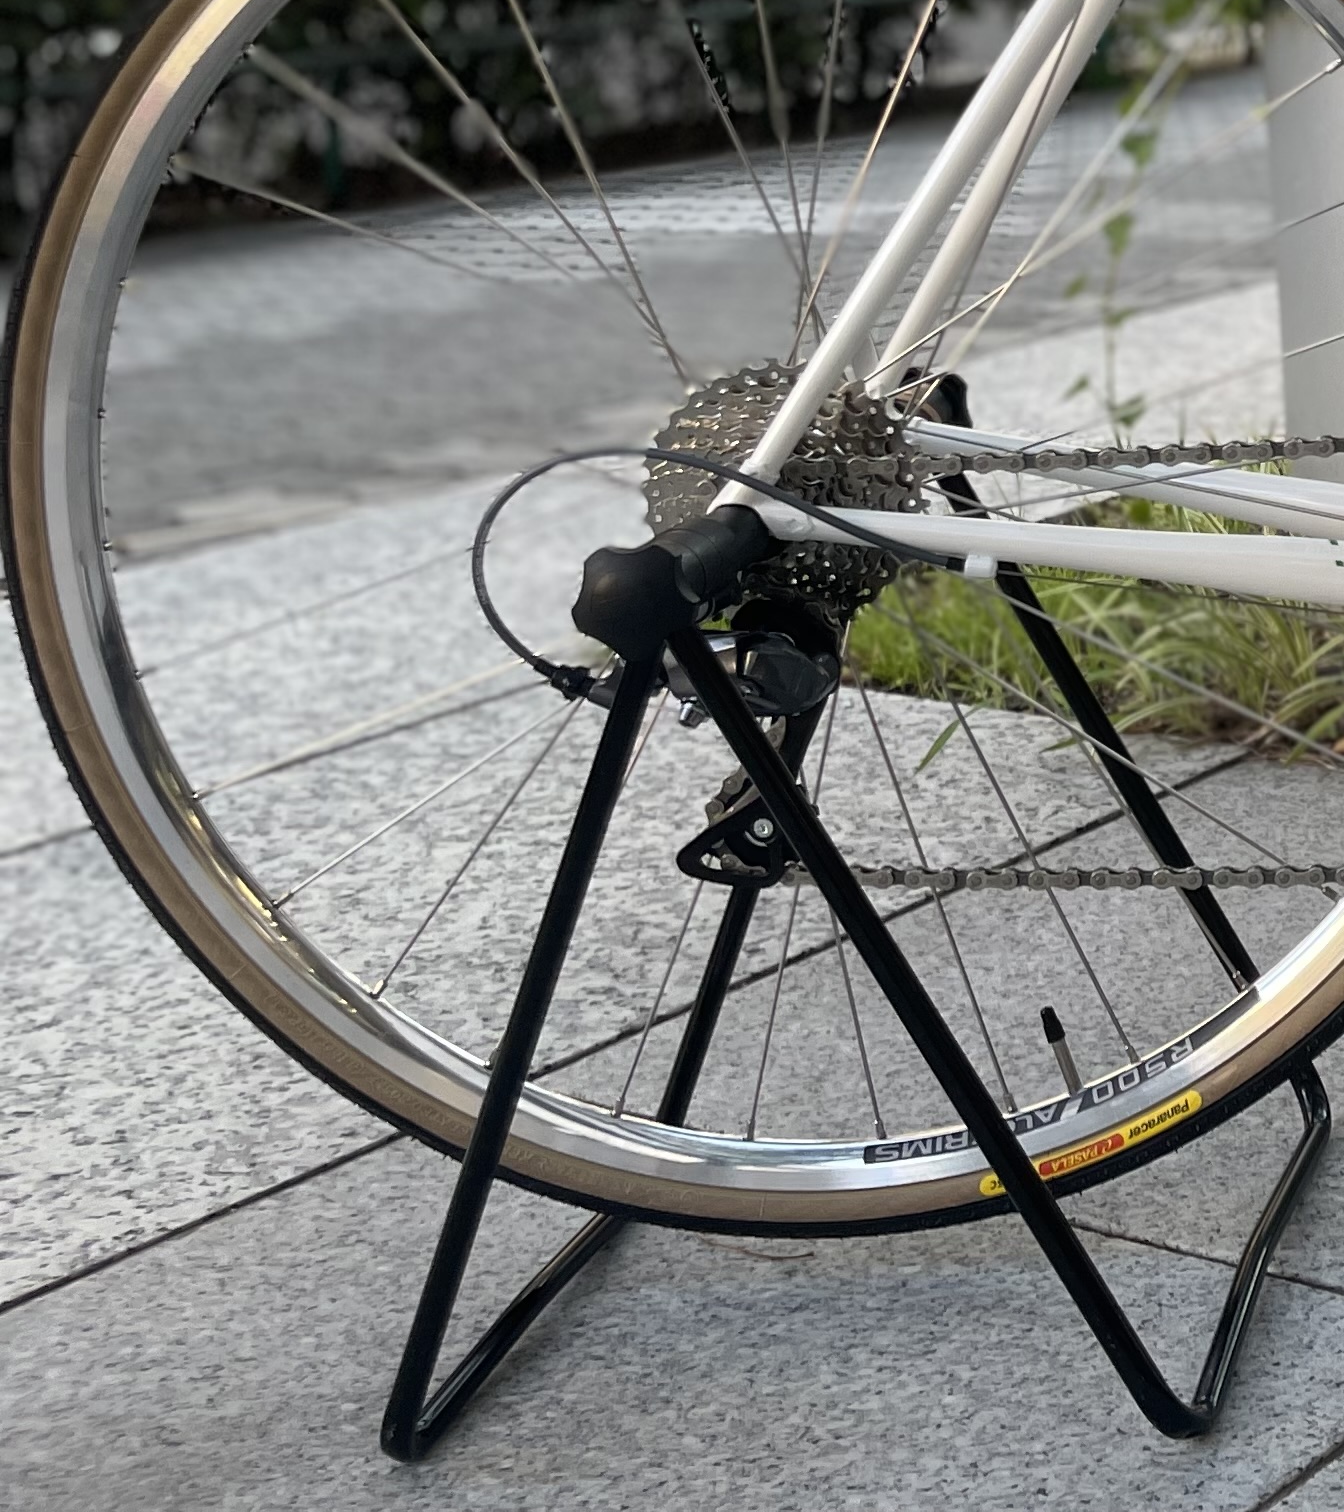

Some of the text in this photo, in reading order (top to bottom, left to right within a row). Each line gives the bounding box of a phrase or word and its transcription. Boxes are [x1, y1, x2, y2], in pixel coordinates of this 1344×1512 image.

[873, 1036, 1195, 1164] R500 ALRIMS
[1051, 1099, 1190, 1172] Panaracer PASELA
